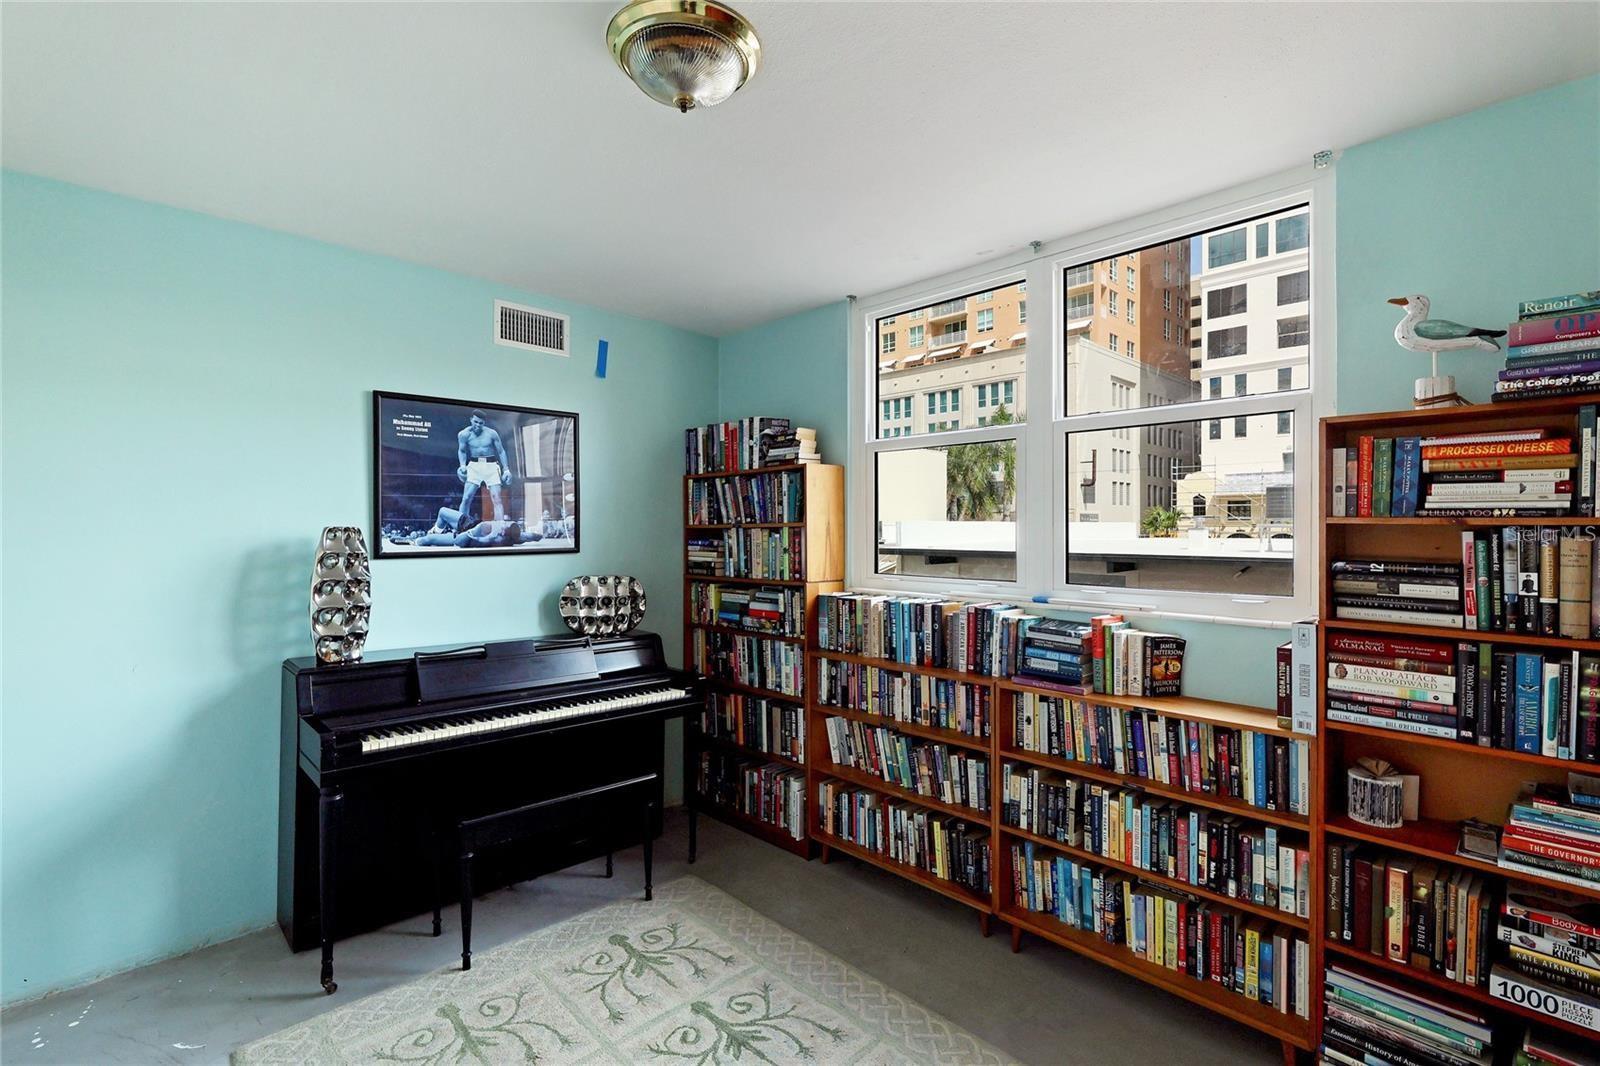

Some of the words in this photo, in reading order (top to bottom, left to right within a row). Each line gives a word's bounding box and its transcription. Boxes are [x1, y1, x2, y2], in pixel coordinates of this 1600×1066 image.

[1524, 296, 1576, 313] Renoir
[1555, 332, 1592, 340] Composers
[1526, 376, 1570, 387] College
[1439, 444, 1505, 456] PROCESSED
[1506, 441, 1555, 453] CHEESE
[1370, 563, 1384, 572] 12
[1466, 566, 1474, 584] Anna
[1339, 642, 1384, 652] ALMANAC
[1354, 667, 1377, 675] PLAN
[1398, 673, 1437, 683] ATTACK
[1375, 676, 1438, 689] WOODWARD
[1331, 701, 1347, 709] Killing
[1348, 703, 1368, 712] England
[1466, 690, 1474, 718] HISTORY
[1332, 713, 1352, 721] KILLING
[1525, 698, 1538, 736] AMERICA
[1529, 844, 1545, 853] THE
[1522, 855, 1537, 864] Walk
[1552, 917, 1577, 930] Body
[1417, 925, 1425, 949] BIBLE
[1552, 942, 1588, 958] STEPHEN
[1552, 948, 1580, 963] KING
[1516, 952, 1538, 964] KATE
[1542, 961, 1590, 979] ATKINSON
[1497, 980, 1559, 1014] 1000
[1561, 1000, 1593, 1014] PIECE
[1561, 1007, 1593, 1021] JIGSAW
[1561, 1013, 1593, 1027] PUZZLE
[1330, 1028, 1358, 1043] Essential
[1364, 1042, 1393, 1059] History
